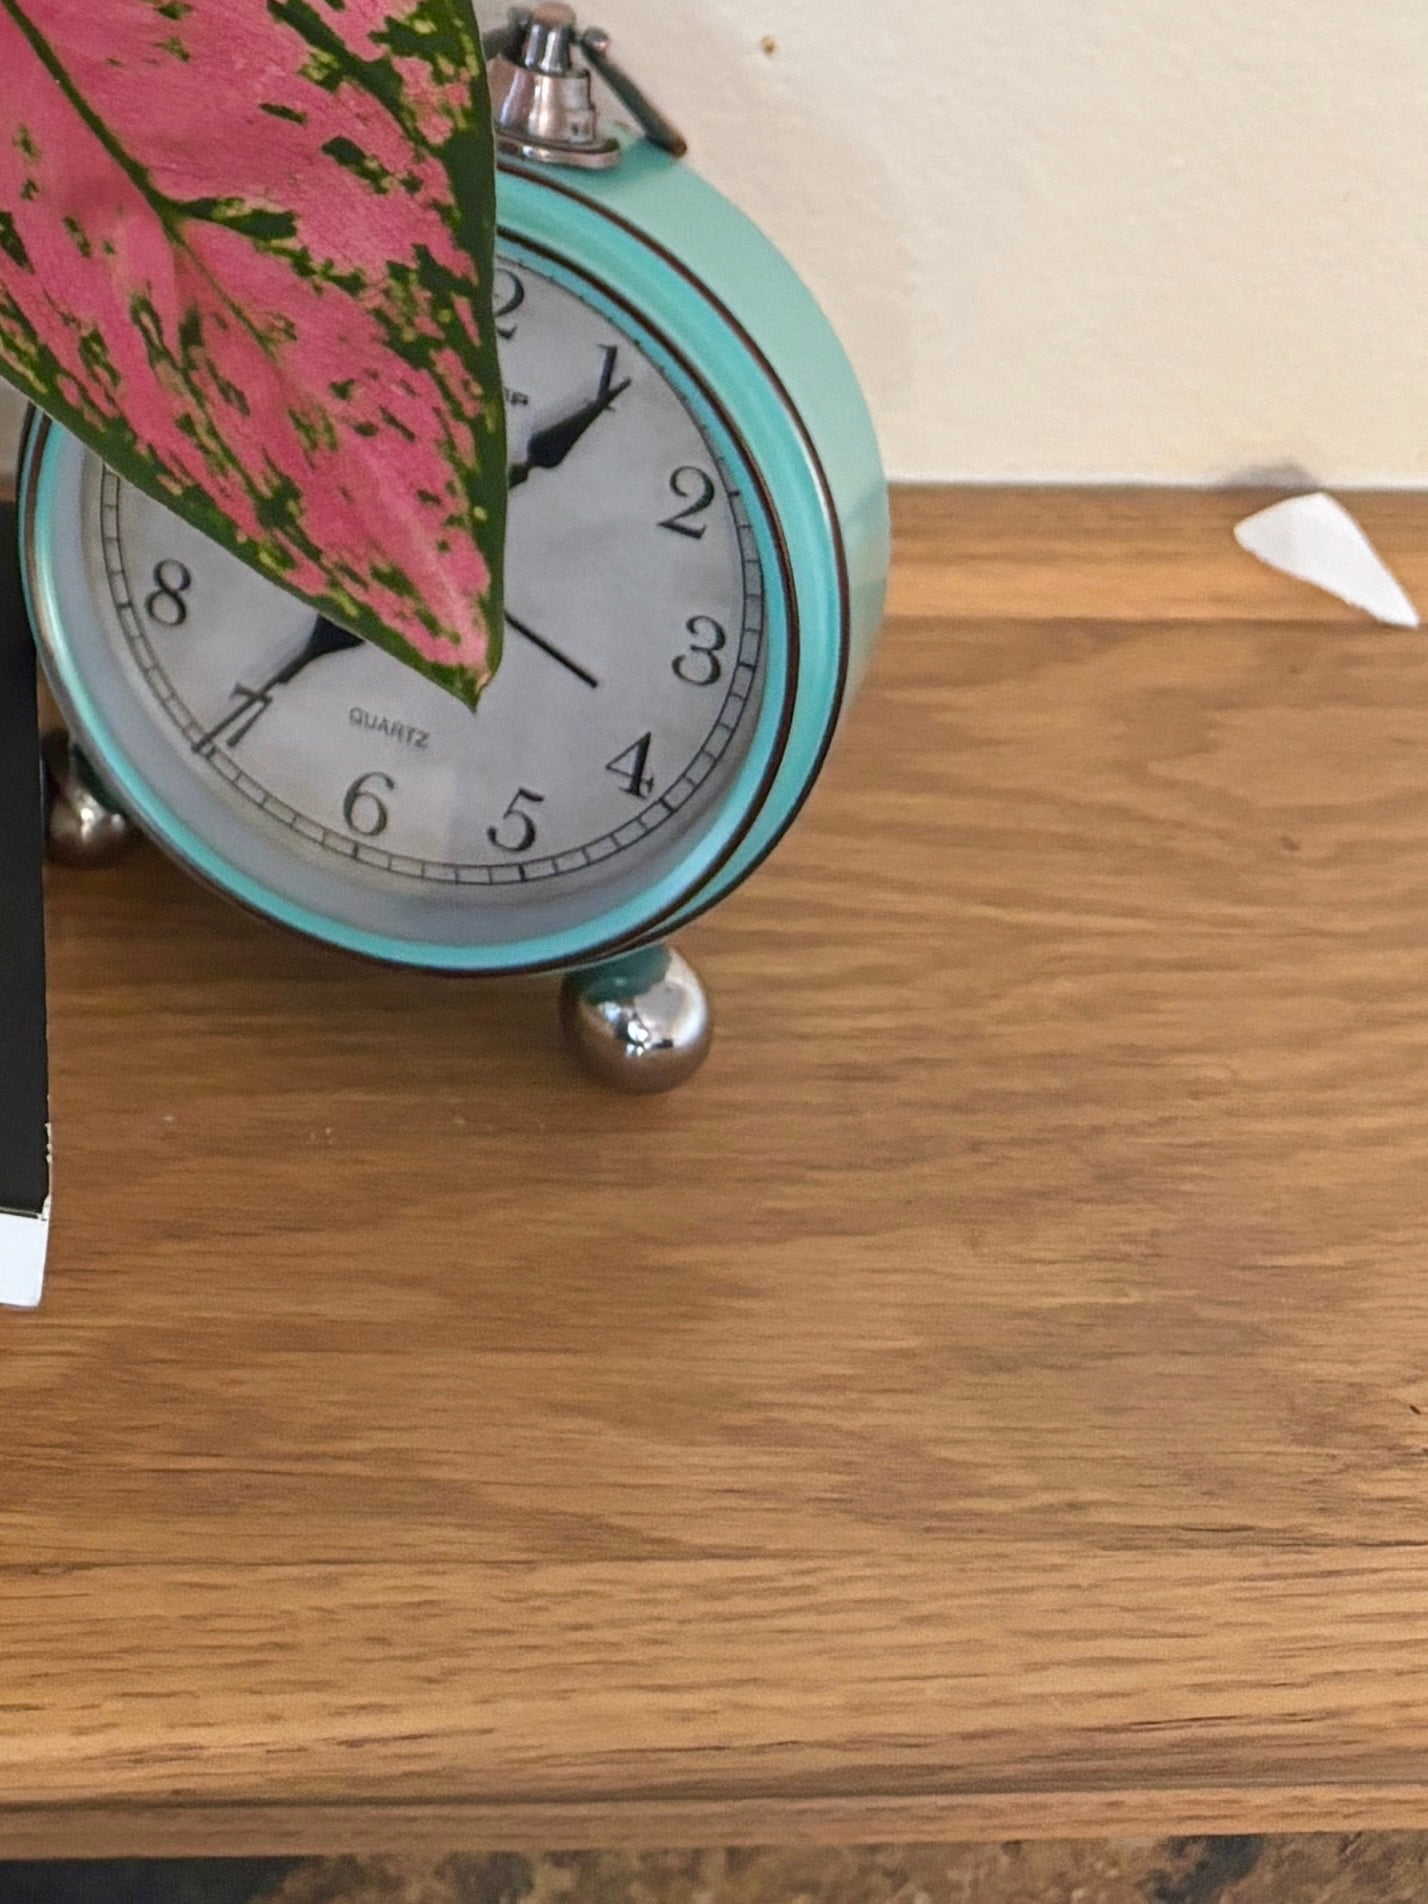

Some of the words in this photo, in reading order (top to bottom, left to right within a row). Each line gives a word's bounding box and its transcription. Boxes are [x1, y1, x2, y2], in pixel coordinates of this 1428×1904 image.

[596, 343, 618, 412] 1
[657, 464, 716, 540] 2
[145, 559, 192, 626] 8
[671, 614, 726, 687] 3
[229, 683, 272, 748] 7
[349, 706, 430, 748] QUARTZ
[605, 732, 654, 799] 4
[343, 771, 395, 837] 6
[486, 786, 545, 852] 5
